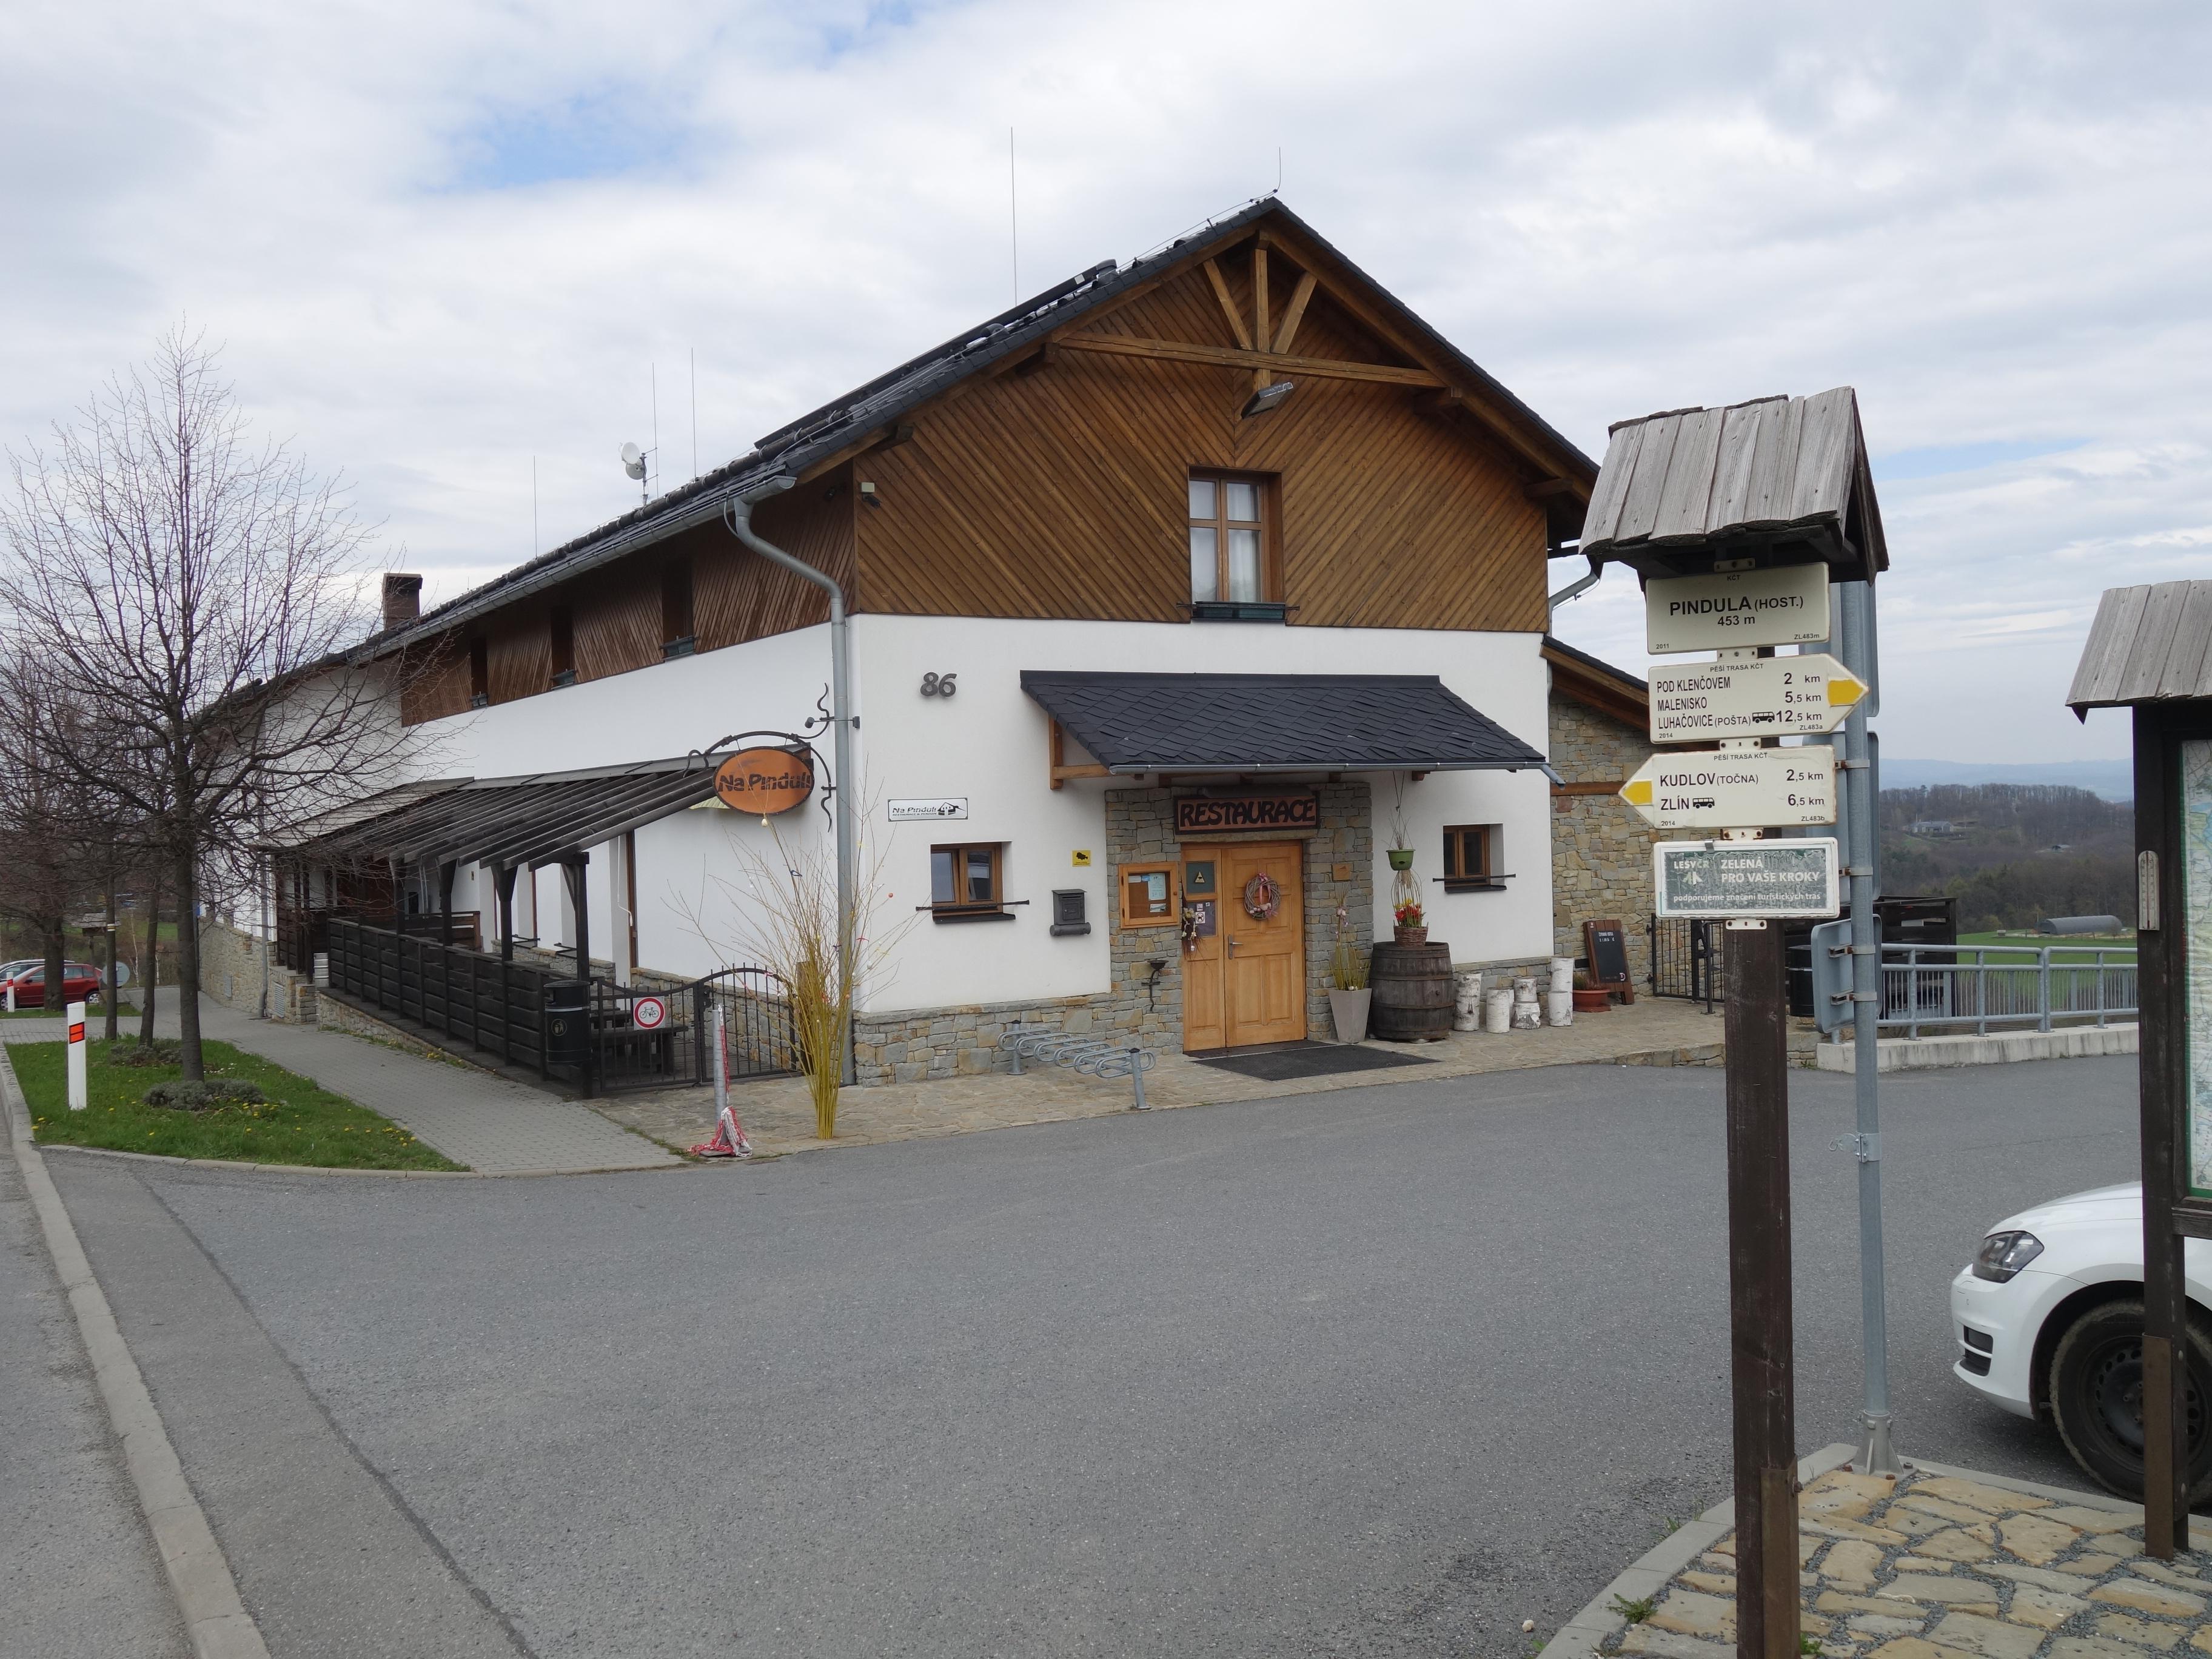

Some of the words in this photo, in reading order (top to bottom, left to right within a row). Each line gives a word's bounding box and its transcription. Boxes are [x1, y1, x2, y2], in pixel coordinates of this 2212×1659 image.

[1669, 595, 1752, 616] PINDULA
[1754, 595, 1804, 612] (HOST.)
[1717, 615, 1740, 626] 453
[1744, 616, 1755, 625] m
[920, 672, 957, 697] 86
[1657, 680, 1675, 693] POD
[1677, 675, 1731, 691] KLENČOVEM
[1784, 672, 1792, 685] 2
[1805, 674, 1820, 683] km
[1657, 697, 1708, 712] MALENISKO
[1785, 691, 1803, 704] 5,5
[1806, 692, 1822, 702] km
[1658, 713, 1713, 730] LUHAČOVICE
[1714, 714, 1752, 728] (POŠTA)
[1776, 709, 1803, 723] 12,5
[1806, 711, 1822, 721] km
[717, 774, 745, 792] Na
[1660, 773, 1715, 787] KUDLOV
[1717, 773, 1759, 786] (TOČNA)
[1786, 769, 1805, 782] 2,5
[1808, 772, 1823, 780] km
[1660, 795, 1689, 811] ZLÍN
[1788, 794, 1805, 807] 6,5
[1808, 796, 1825, 805] km
[1179, 798, 1316, 827] RESTAURACE
[1721, 857, 1764, 869] ZELENÁ
[1721, 873, 1744, 883] PRO
[1746, 870, 1775, 882] VAŠE
[1779, 871, 1820, 882] KROKY
[1674, 893, 1725, 903] podporujeme
[1758, 892, 1803, 902] turistických
